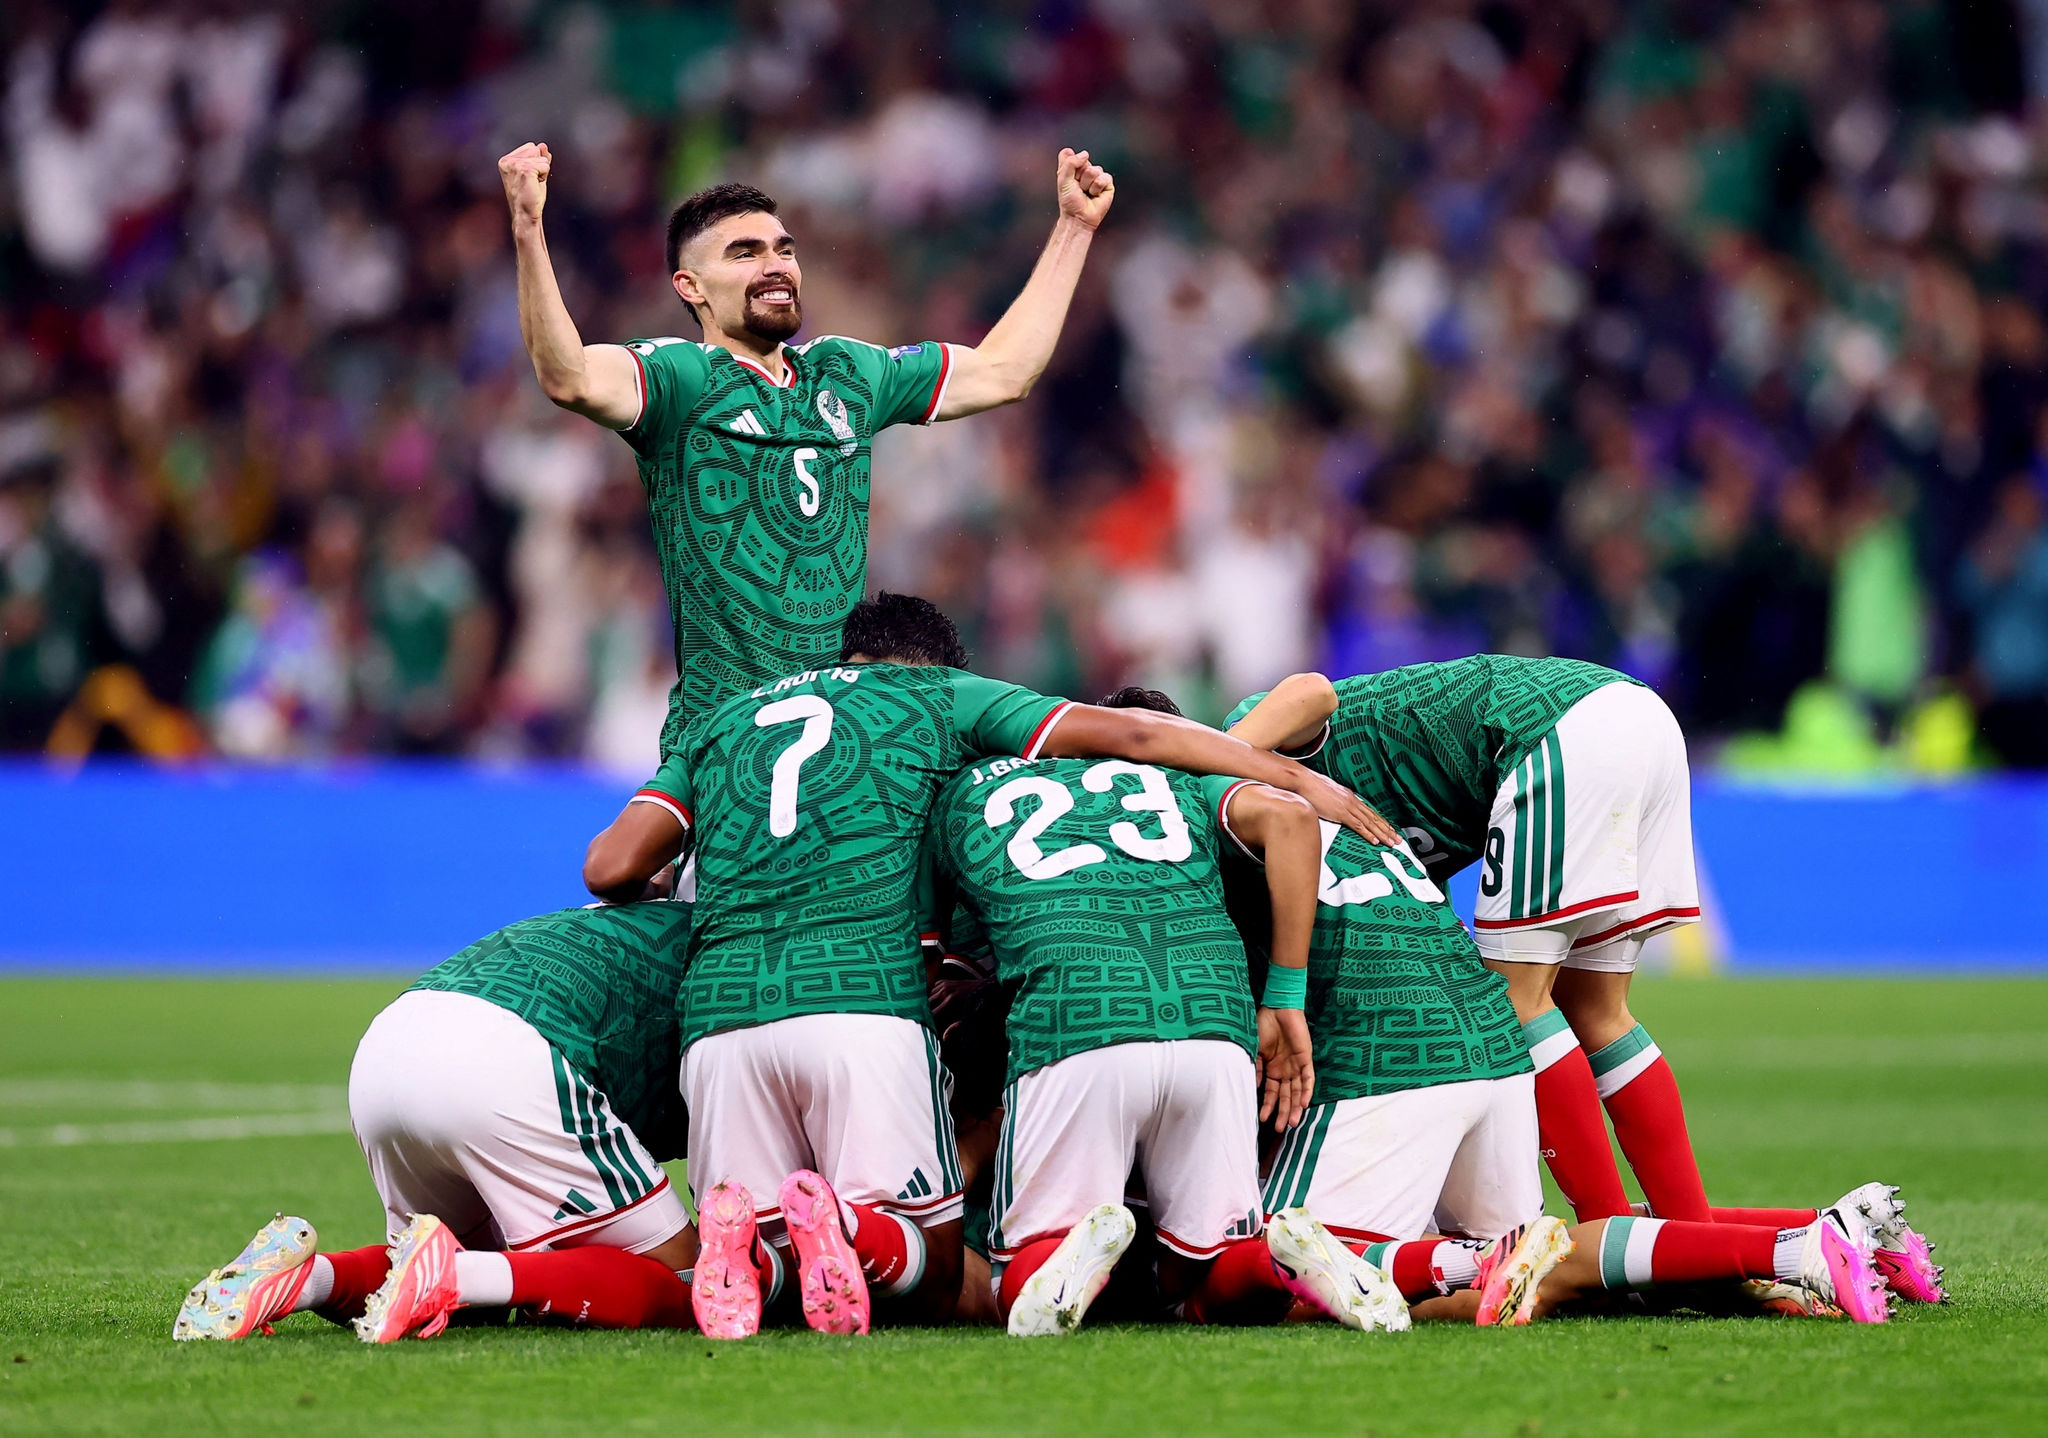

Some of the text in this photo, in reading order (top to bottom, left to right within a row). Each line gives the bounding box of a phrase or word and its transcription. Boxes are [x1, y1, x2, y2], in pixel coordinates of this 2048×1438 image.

[793, 447, 820, 517] 5
[754, 694, 834, 838] 7
[983, 760, 1193, 880] 23
